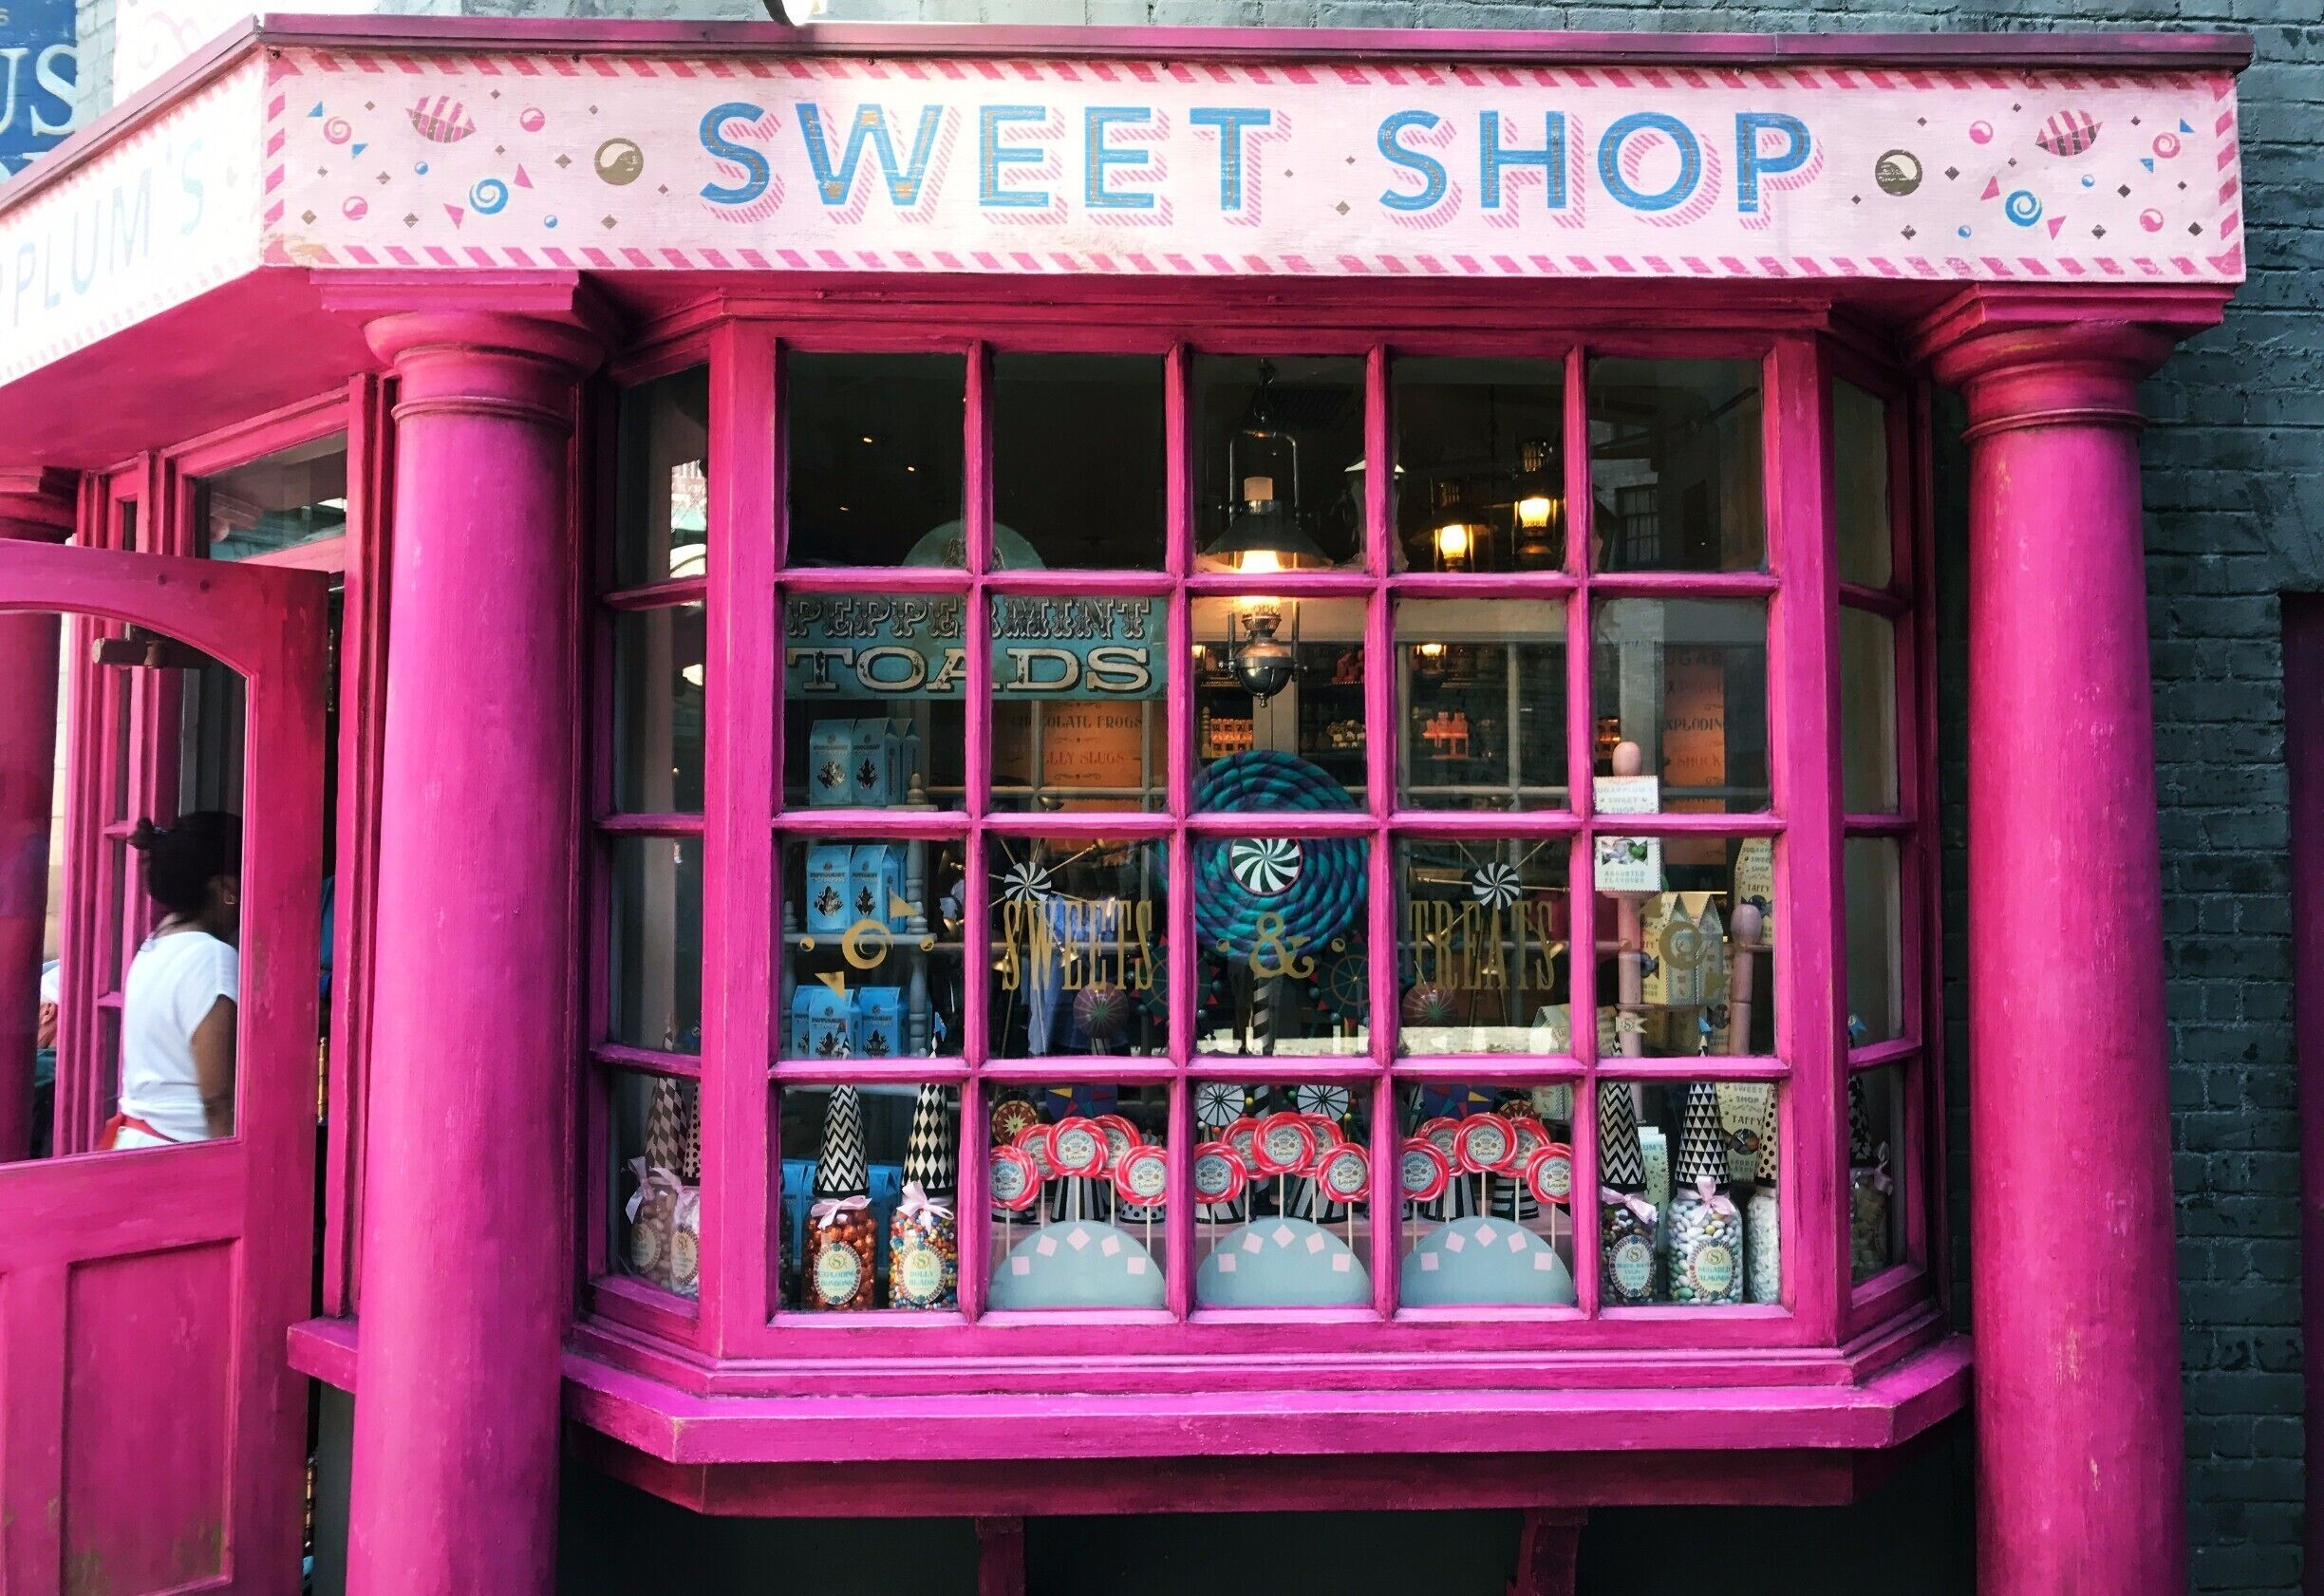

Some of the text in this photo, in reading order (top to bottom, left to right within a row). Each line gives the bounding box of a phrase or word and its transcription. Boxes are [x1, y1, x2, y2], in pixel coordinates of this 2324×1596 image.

[699, 102, 1817, 222] SWEET SHOP
[0, 138, 206, 327] PLUM'S
[787, 596, 1152, 640] PEPPEMINT
[1665, 718, 1723, 731] XPLODIN
[1002, 899, 1556, 991] SWEETS & TREATS
